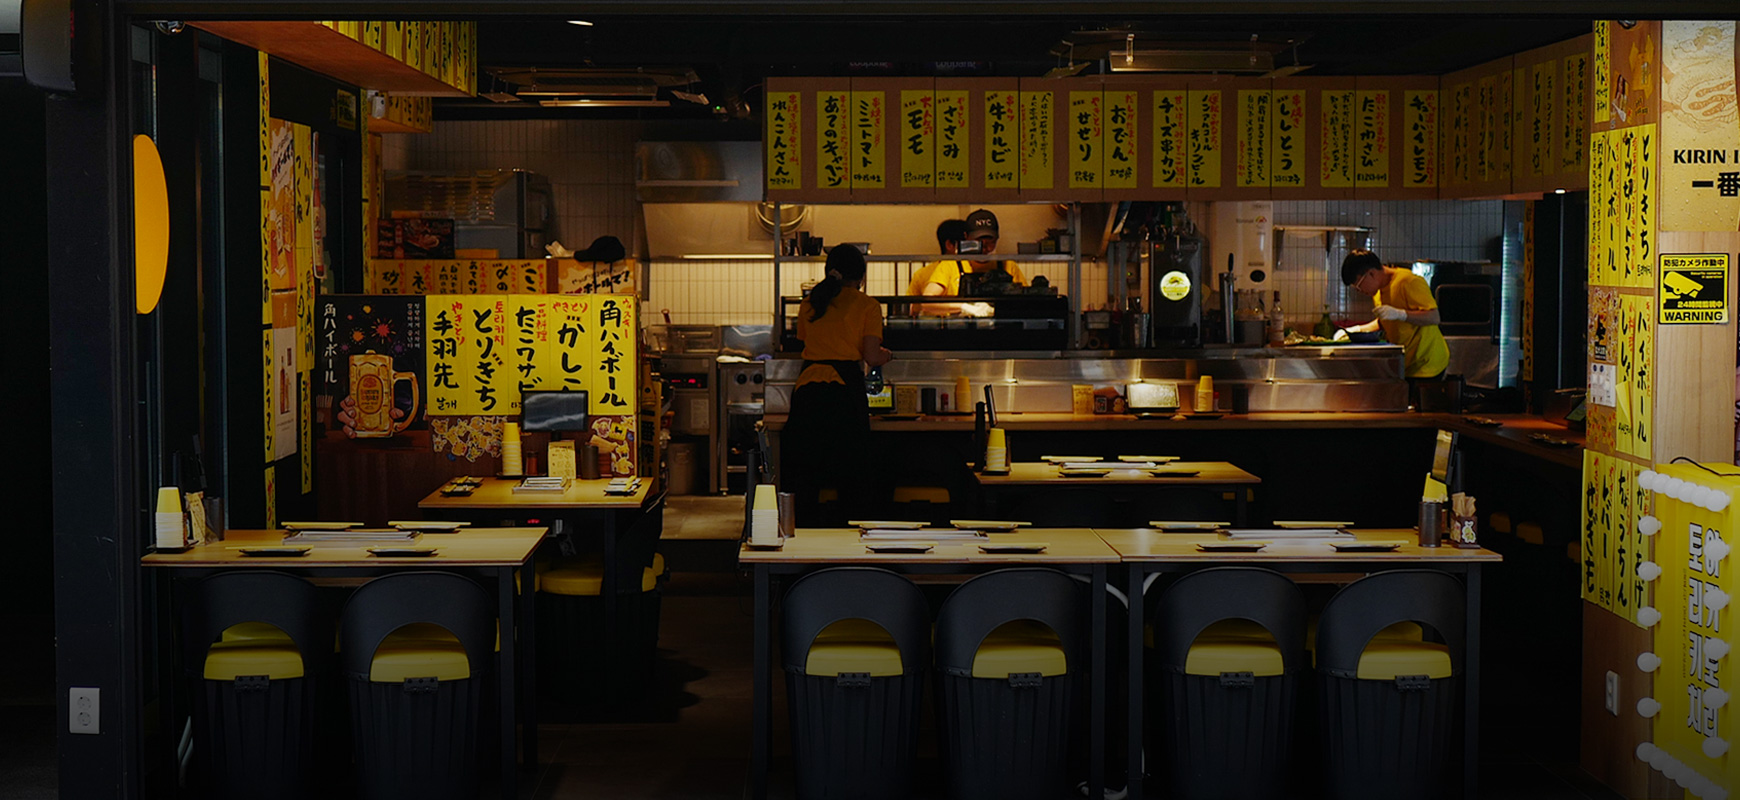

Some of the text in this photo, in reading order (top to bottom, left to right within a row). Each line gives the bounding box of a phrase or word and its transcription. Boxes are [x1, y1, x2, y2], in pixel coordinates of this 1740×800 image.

[822, 95, 844, 187] あてのキャベツ
[858, 100, 873, 167] ミニトマト
[907, 109, 924, 155] モモ
[943, 106, 960, 159] ささみ
[989, 102, 1011, 164] 牛カルビ
[1076, 112, 1093, 162] せせり
[1110, 104, 1129, 162] おでん
[1158, 96, 1177, 183] チーズ串カツ
[1202, 94, 1213, 152] ノンアルコール
[1279, 102, 1294, 171] ししとう
[1360, 96, 1380, 168] たこわさび
[1190, 129, 1206, 185] キリンビール
[1674, 149, 1726, 164] KIRIN
[1692, 172, 1740, 197] 一番
[975, 218, 992, 227] NYC
[1607, 134, 1617, 272] ハイボール
[1640, 134, 1650, 261] とりきち
[1663, 259, 1725, 267] 防犯カメラ作動中
[451, 301, 465, 345] やきとり
[494, 300, 504, 346] 토리키치
[535, 302, 548, 342] 一品料理
[552, 302, 588, 314] やきとり
[1664, 311, 1723, 321] WARNING
[323, 302, 339, 384] 角ハイボール
[431, 309, 460, 390] 手羽先
[557, 322, 585, 392] かし
[599, 300, 628, 408] 角ハイボール
[436, 397, 457, 411] 날개
[1637, 312, 1647, 443] ハイボール
[1688, 522, 1703, 735] 토리키치
